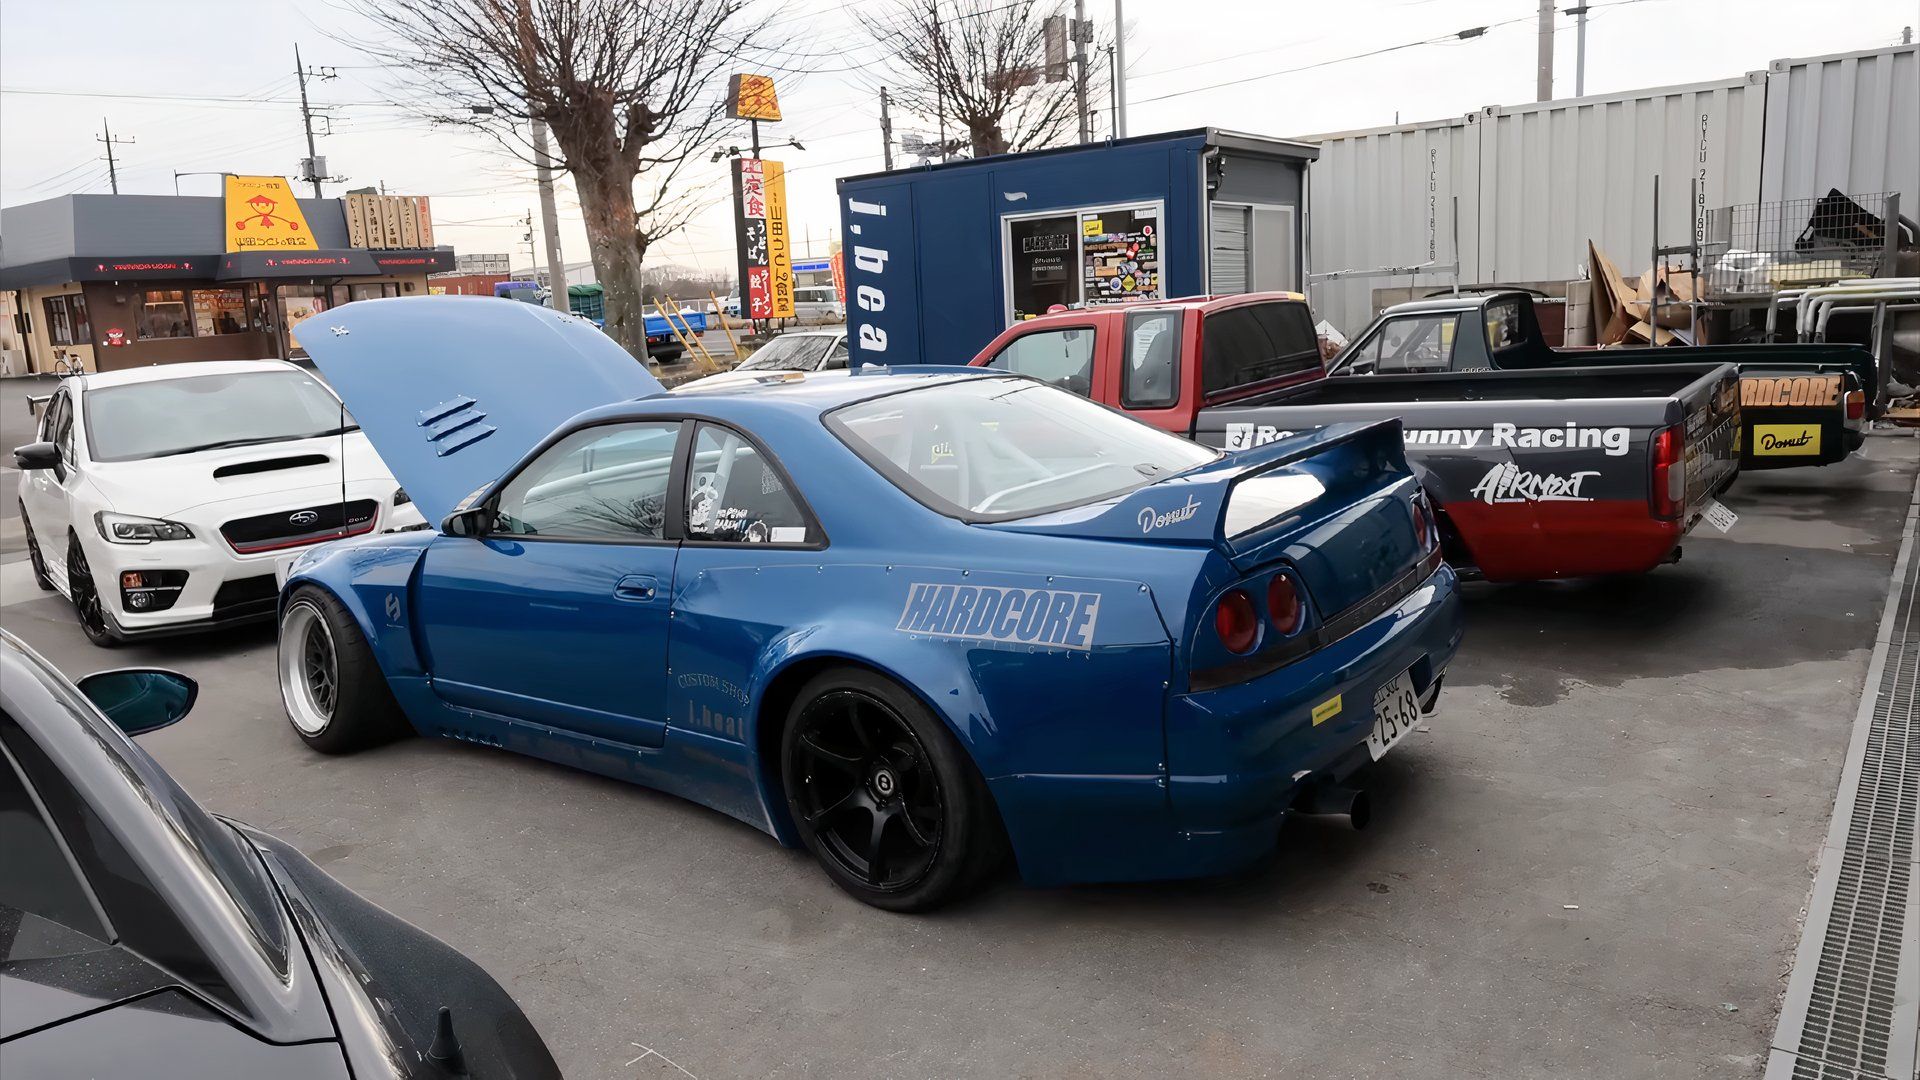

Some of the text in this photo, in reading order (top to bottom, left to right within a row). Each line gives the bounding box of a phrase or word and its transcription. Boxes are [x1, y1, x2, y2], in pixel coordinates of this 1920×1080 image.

[746, 226, 758, 259] そば
[757, 219, 768, 265] うどん
[750, 274, 762, 312] 餃子
[760, 269, 772, 315] ラーメン
[849, 197, 888, 370] j.bea
[1741, 378, 1840, 407] RDCORE
[1403, 422, 1631, 456] unny Racing
[1761, 430, 1813, 451] Donut
[1138, 494, 1202, 534] Donut
[897, 583, 1100, 649] HARDCORE
